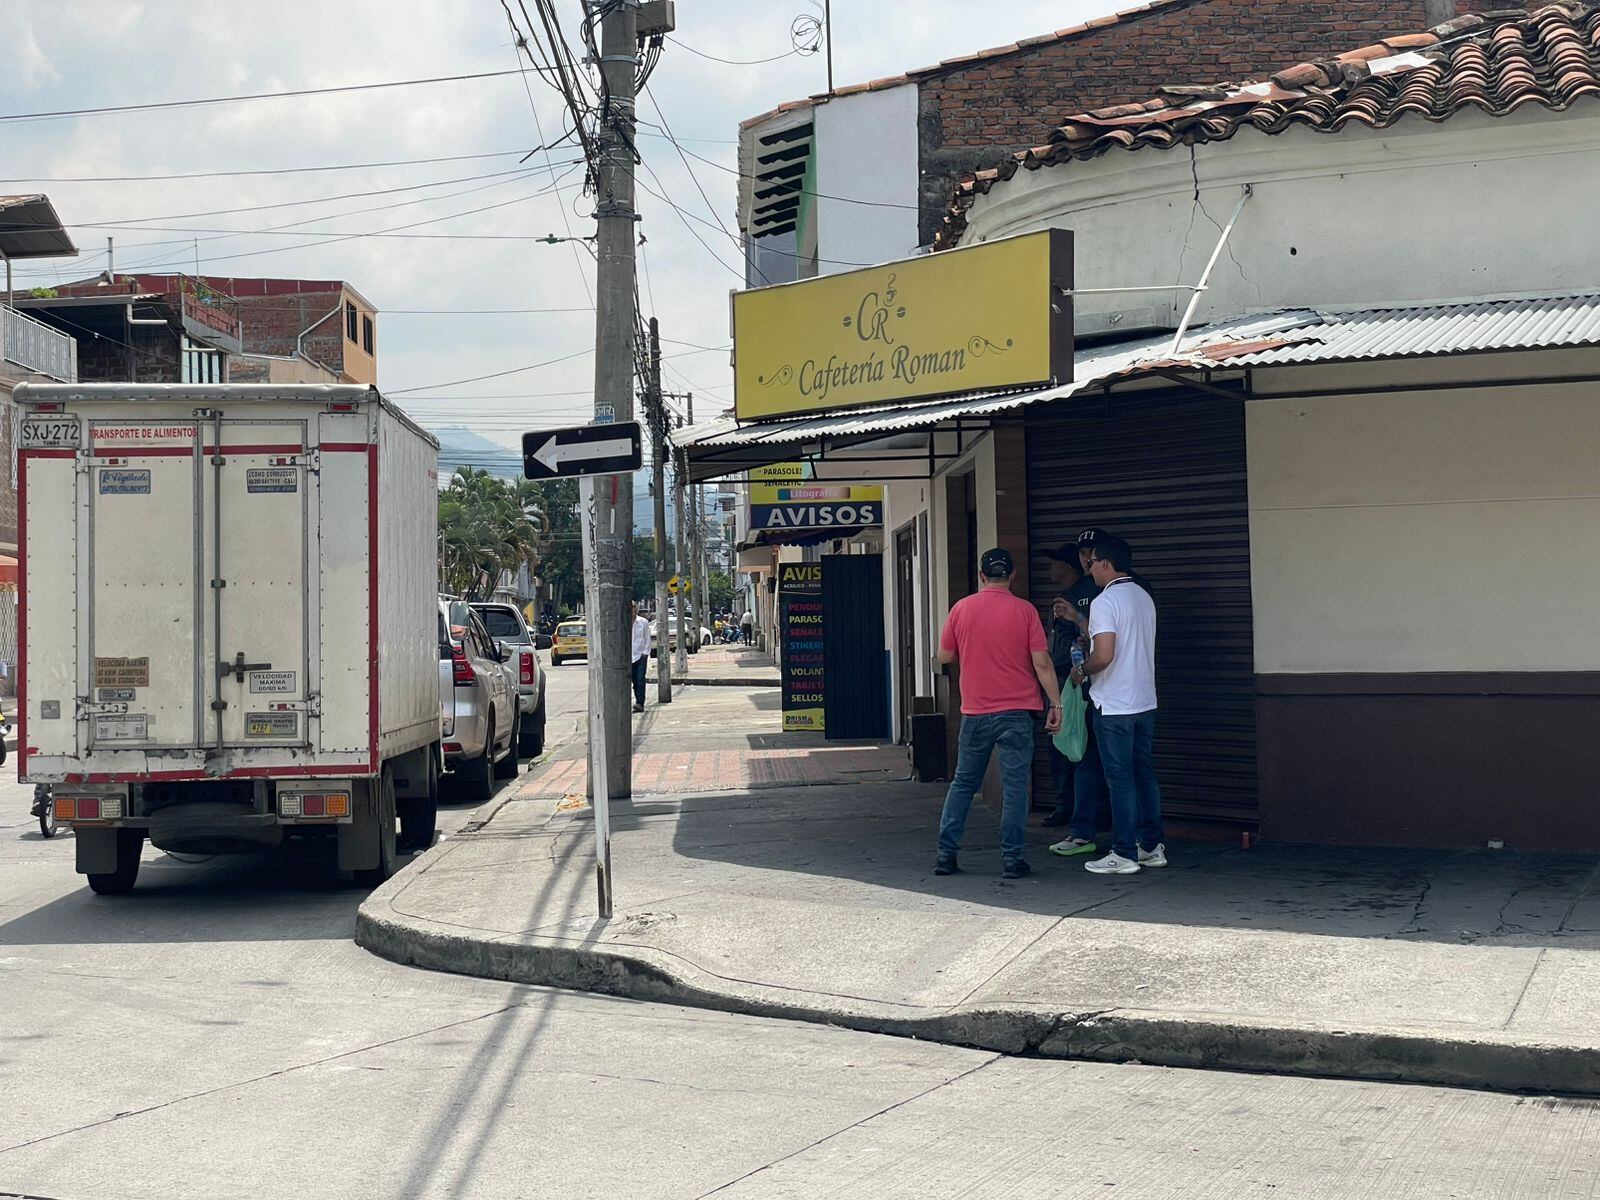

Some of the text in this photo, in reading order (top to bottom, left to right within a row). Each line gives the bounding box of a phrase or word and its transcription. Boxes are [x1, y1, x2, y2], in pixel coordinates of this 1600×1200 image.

[799, 345, 966, 400] Cafetería Roman
[90, 428, 197, 439] TRANSPORTE DE ALIMENTOS
[767, 505, 874, 527] AVISOS
[1078, 530, 1095, 542] CTI
[1077, 597, 1089, 607] CTI
[791, 694, 824, 702] SELLOS
